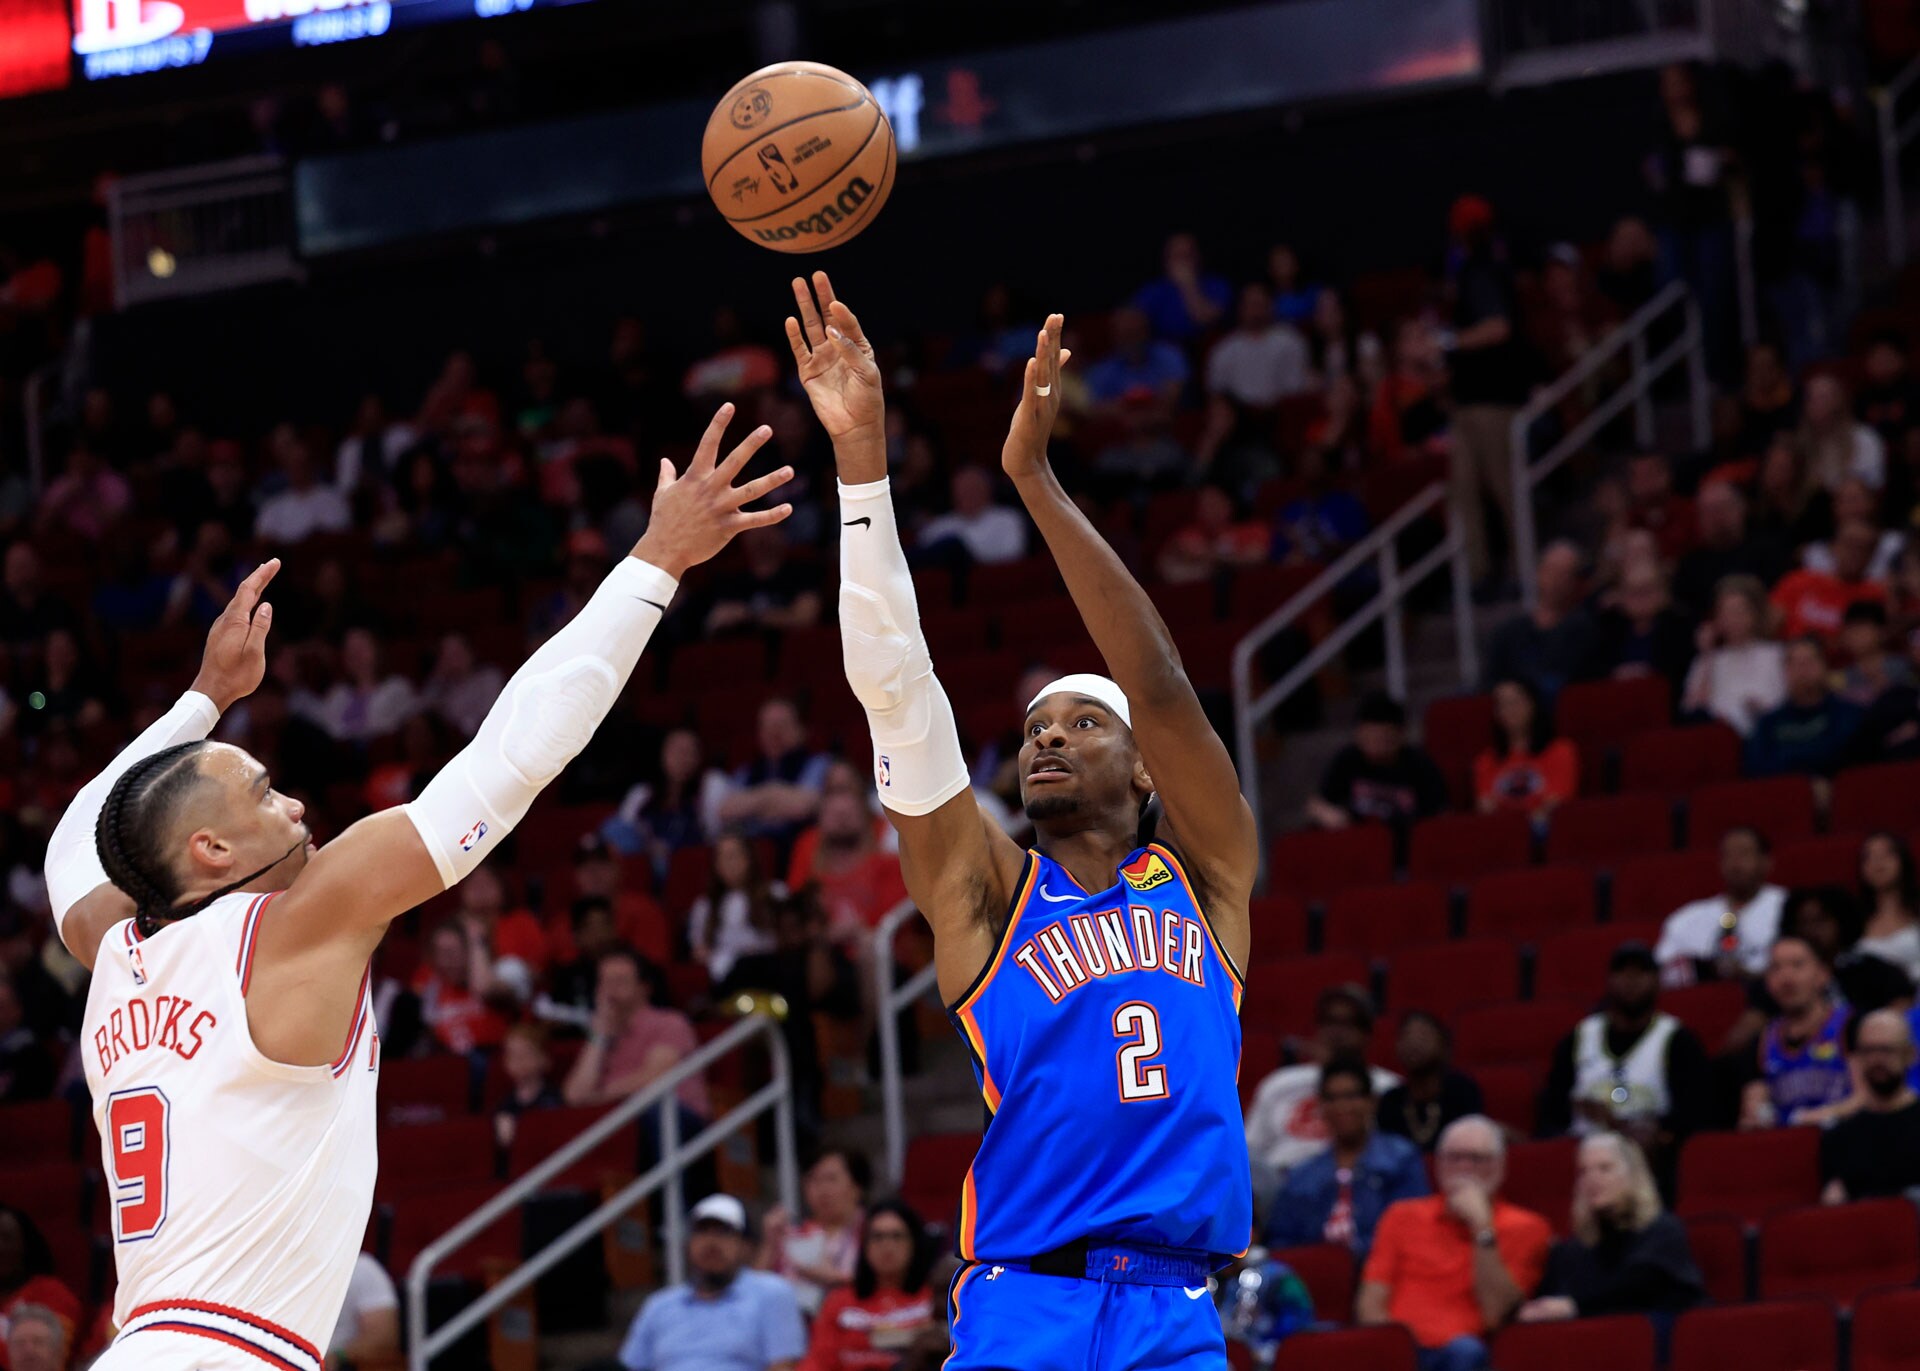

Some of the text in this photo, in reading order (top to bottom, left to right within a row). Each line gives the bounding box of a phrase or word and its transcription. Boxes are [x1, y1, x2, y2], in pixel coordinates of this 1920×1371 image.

[752, 177, 874, 241] Wilson
[1013, 904, 1206, 1004] THUNDER
[1112, 1000, 1170, 1103] 2
[106, 1085, 170, 1243] 9
